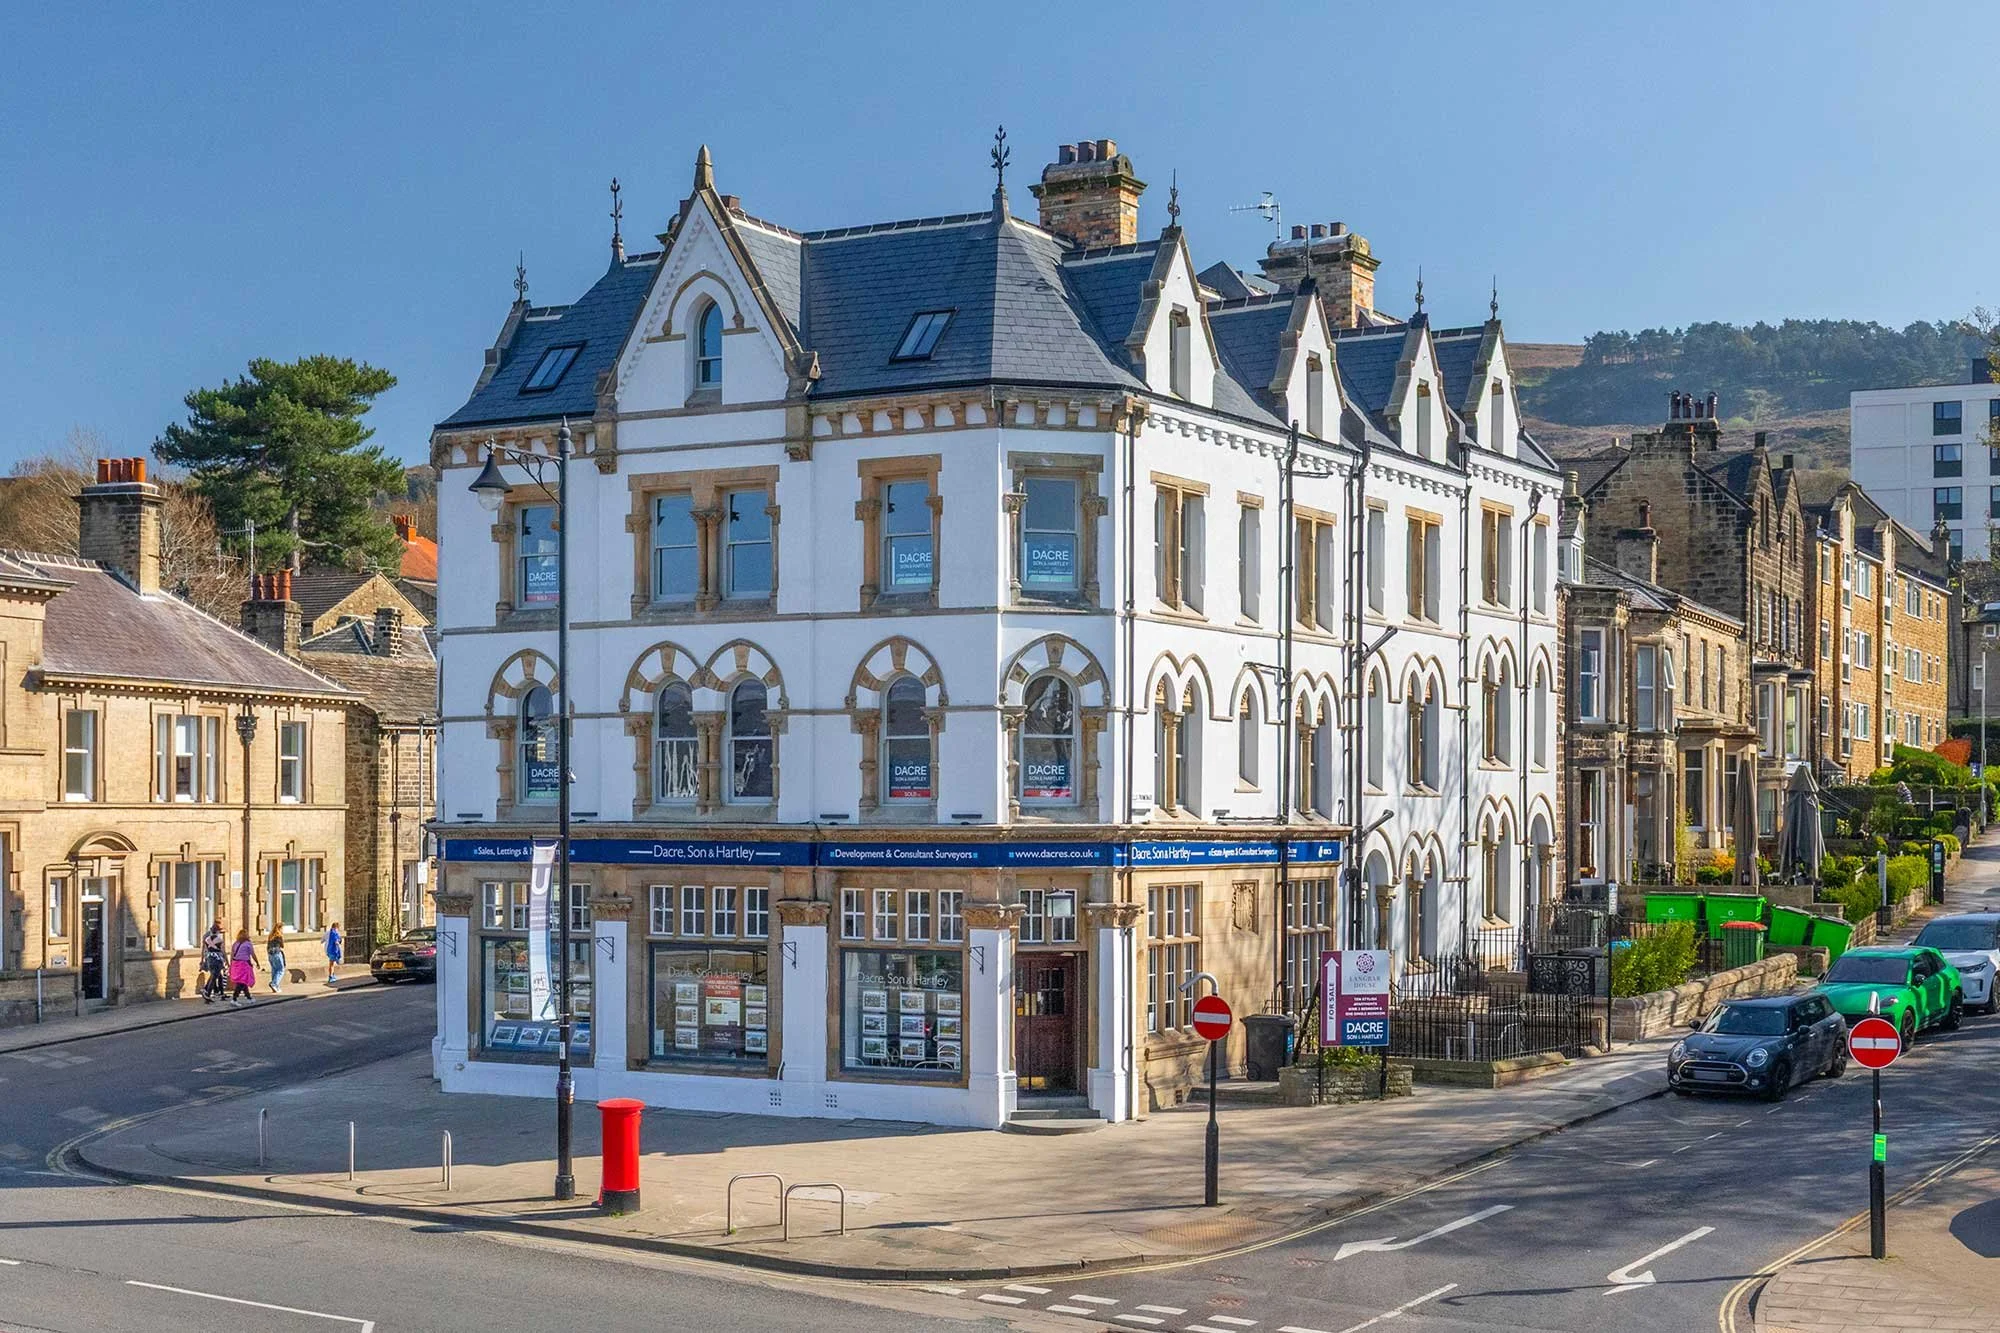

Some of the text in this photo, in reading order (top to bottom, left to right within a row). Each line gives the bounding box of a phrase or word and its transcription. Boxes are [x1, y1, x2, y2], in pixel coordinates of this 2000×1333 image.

[899, 552, 932, 563] DACRE
[1032, 549, 1069, 561] DACRE
[528, 571, 557, 582] DACRE
[531, 768, 560, 778] DACRE
[894, 766, 927, 776] DACRE
[1028, 765, 1065, 775] DACRE
[478, 846, 496, 856] Sales,
[496, 846, 522, 857] Lettings
[522, 847, 528, 855] &
[653, 845, 755, 861] Dacre, Son & Hartley
[835, 848, 972, 861] Development & Consultant Surveyors
[1015, 849, 1093, 859] www.dacres.co.uk
[1152, 846, 1165, 860] Son
[1168, 846, 1191, 862] Hartley
[696, 967, 713, 978] Son
[720, 967, 753, 982] Hartley
[887, 972, 905, 984] Son
[906, 977, 912, 985] &
[913, 974, 949, 989] Hartley
[1346, 1022, 1384, 1033] DACRE
